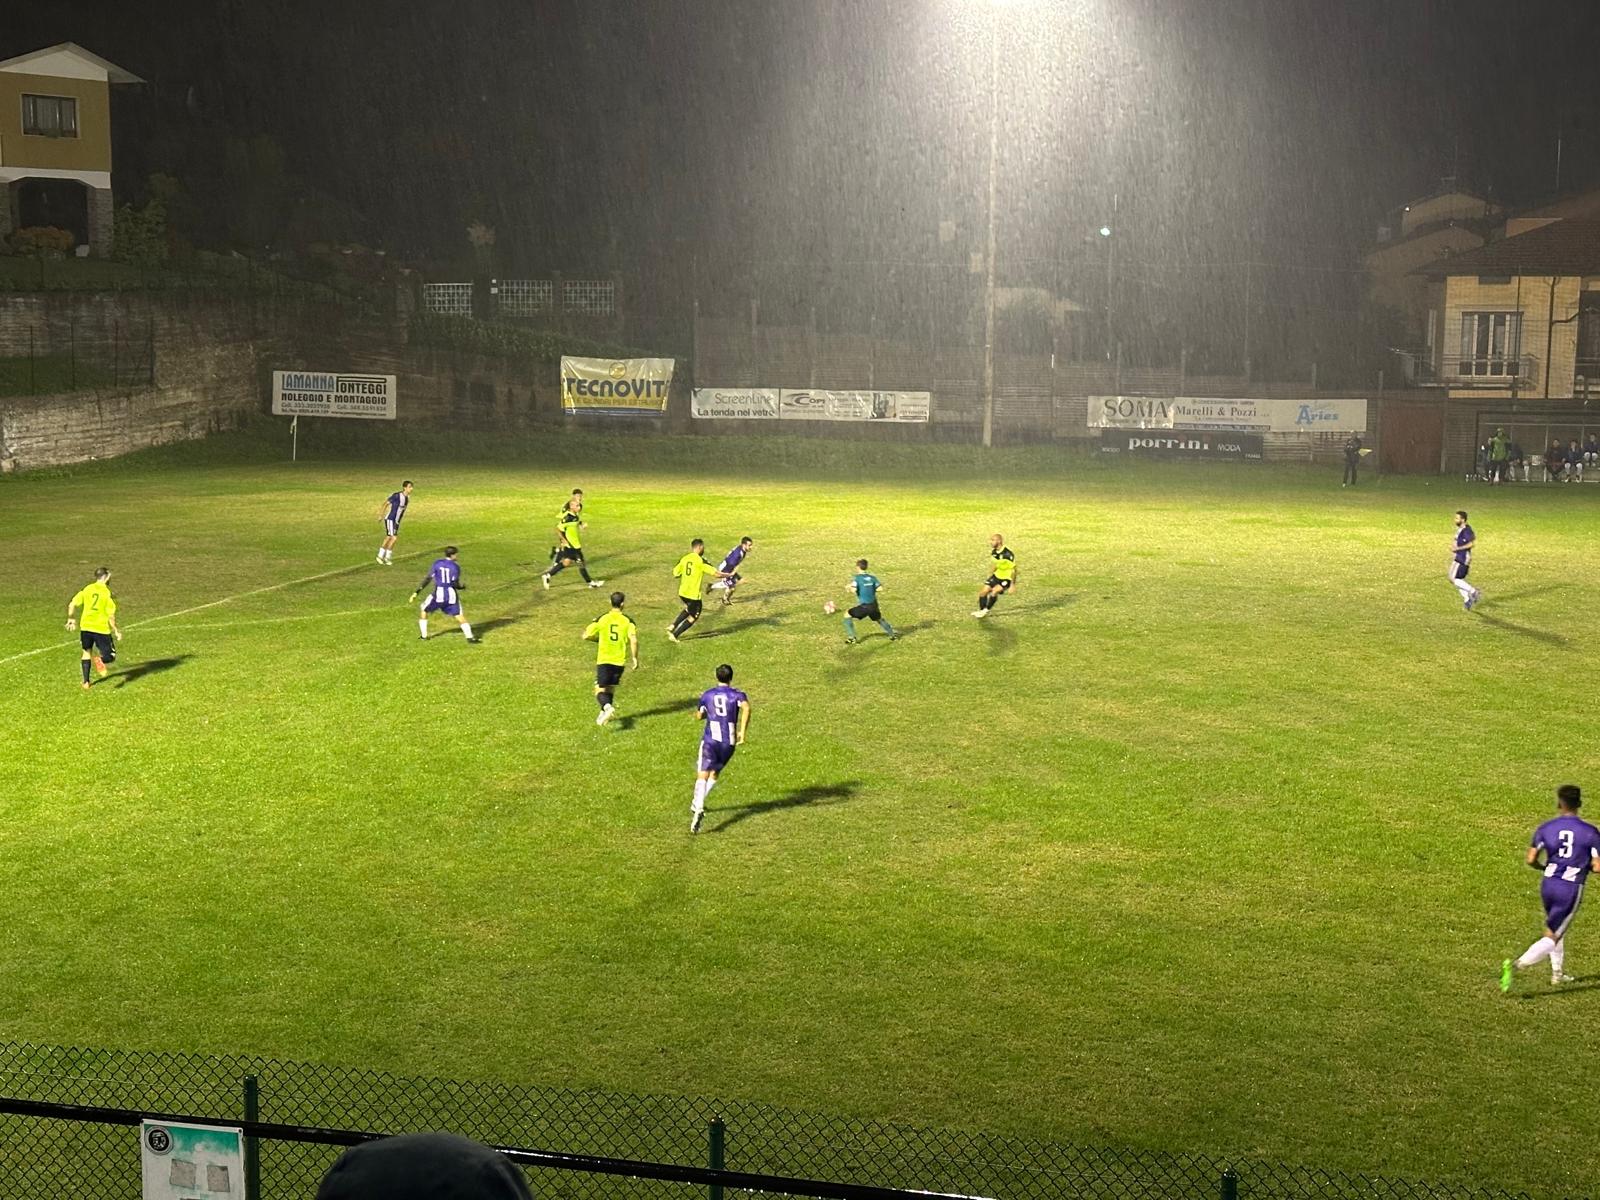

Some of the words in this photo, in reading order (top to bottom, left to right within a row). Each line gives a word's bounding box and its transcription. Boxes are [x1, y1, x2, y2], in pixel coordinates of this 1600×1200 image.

[282, 374, 335, 392] LAMANNA
[563, 379, 665, 398] TECNOVIT
[281, 393, 324, 403] NOLEGGIO
[326, 395, 332, 403] E
[334, 396, 387, 405] MONTAGGIO
[697, 408, 709, 416] La
[710, 408, 735, 417] tenda
[737, 408, 751, 417] nel
[1103, 399, 1168, 418] SOMA
[1176, 406, 1213, 416] Marelli
[1217, 406, 1225, 416] &
[1230, 406, 1257, 417] Pozzi
[1295, 405, 1339, 425] Aries
[1128, 436, 1209, 451] porrini
[1217, 443, 1241, 453] MODA
[439, 566, 451, 584] 11
[684, 561, 693, 577] 6
[90, 592, 100, 611] 2
[609, 624, 619, 642] 5
[713, 694, 728, 717] 9
[1558, 829, 1574, 858] 3
